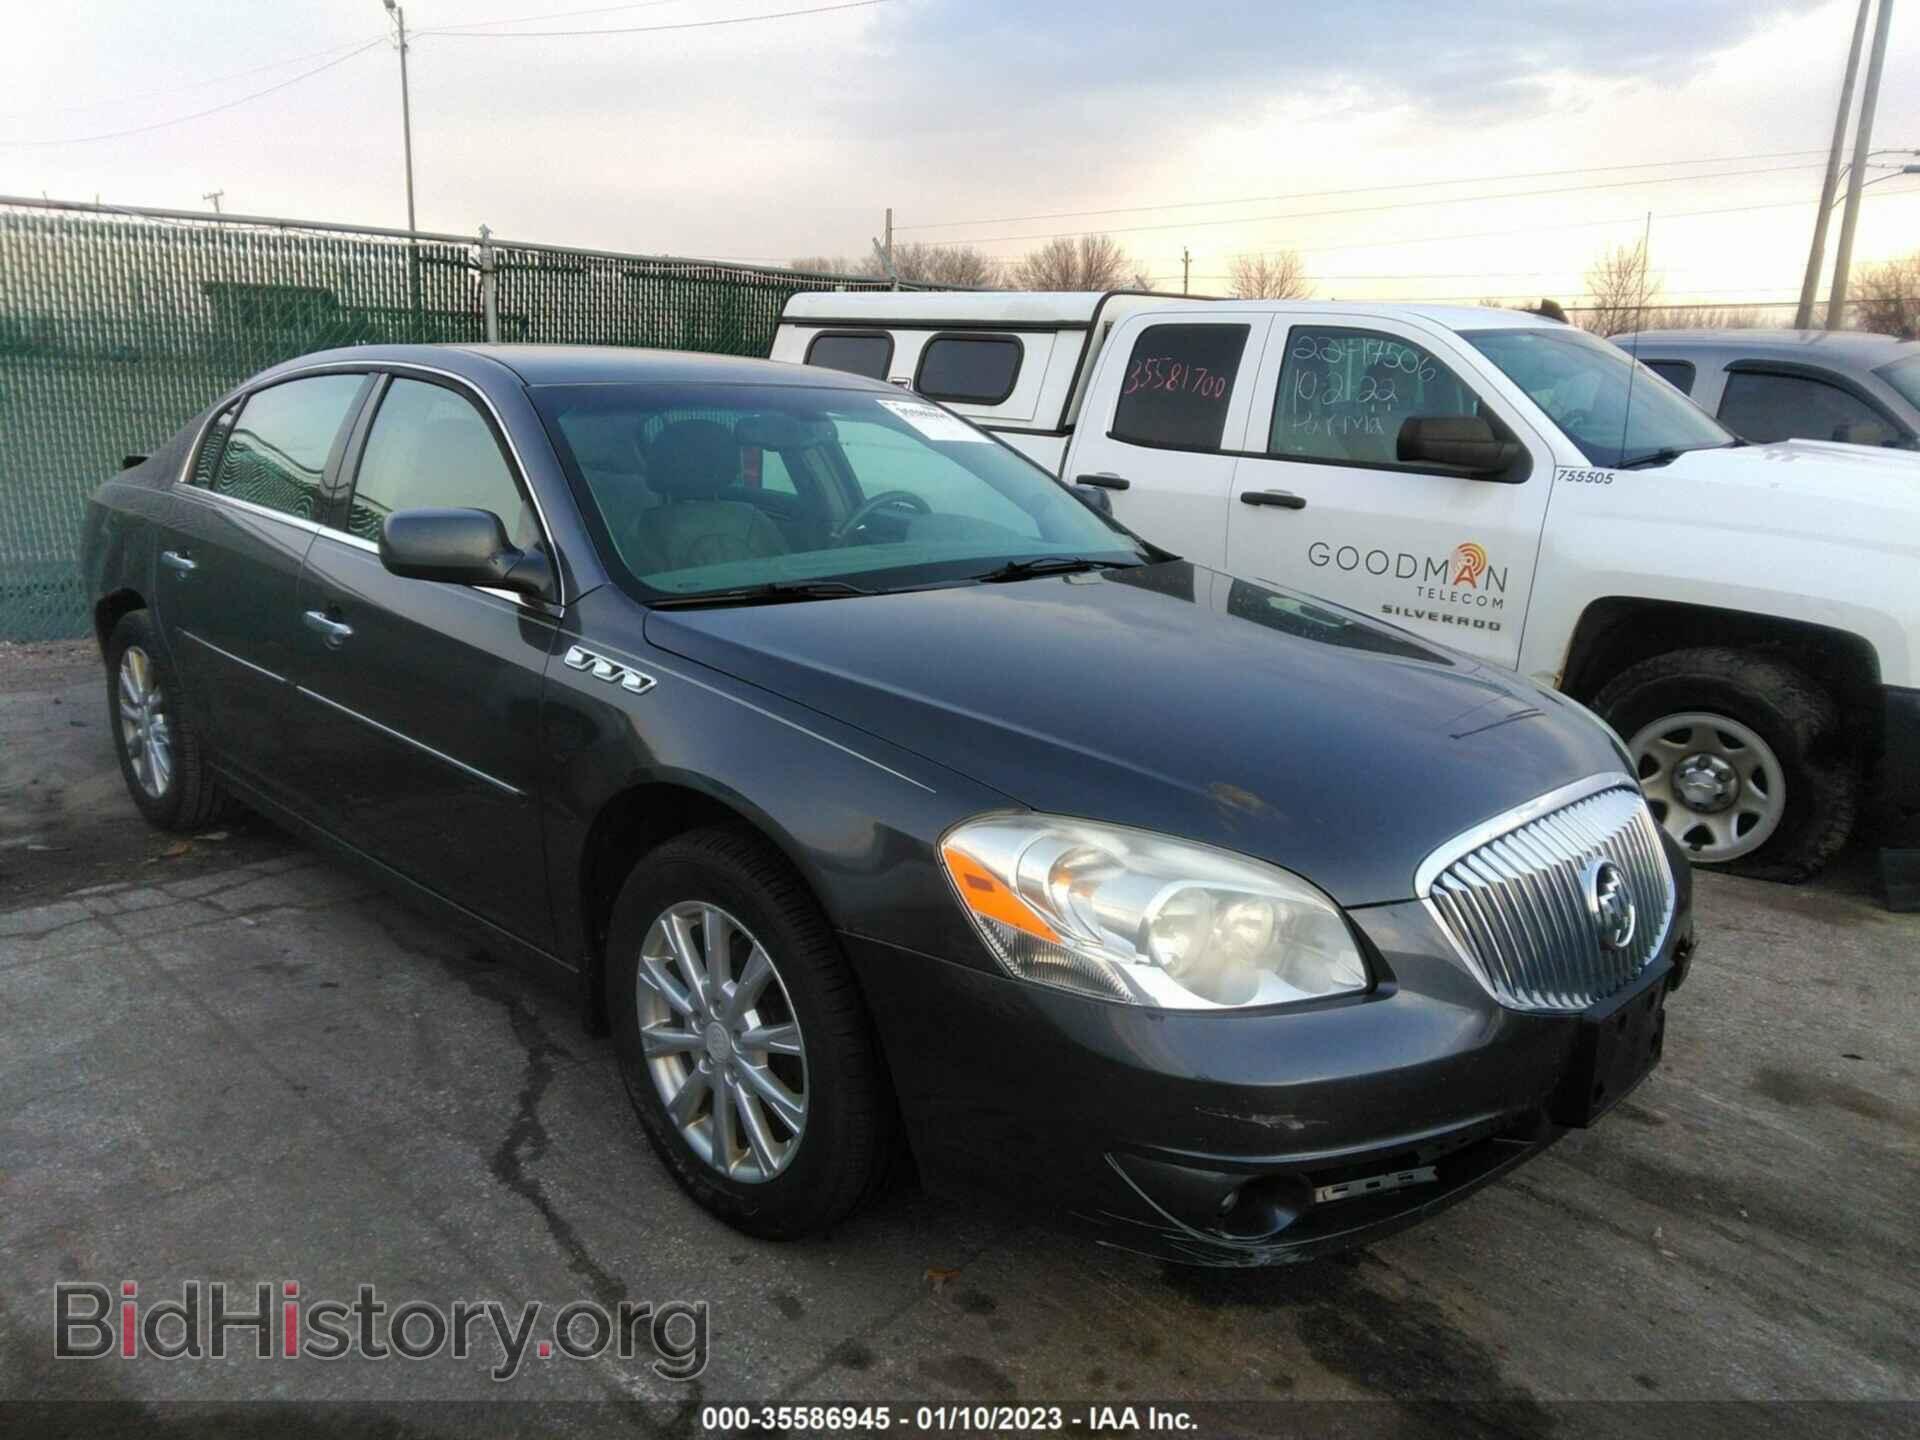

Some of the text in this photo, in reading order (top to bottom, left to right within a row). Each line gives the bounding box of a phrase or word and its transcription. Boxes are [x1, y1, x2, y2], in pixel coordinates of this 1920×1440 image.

[1124, 357, 1226, 398] 35581700
[1558, 469, 1615, 485] 755505
[1308, 541, 1508, 593] GOODMAN
[1416, 585, 1505, 609] TELECOM
[1381, 603, 1501, 632] SILVERADO
